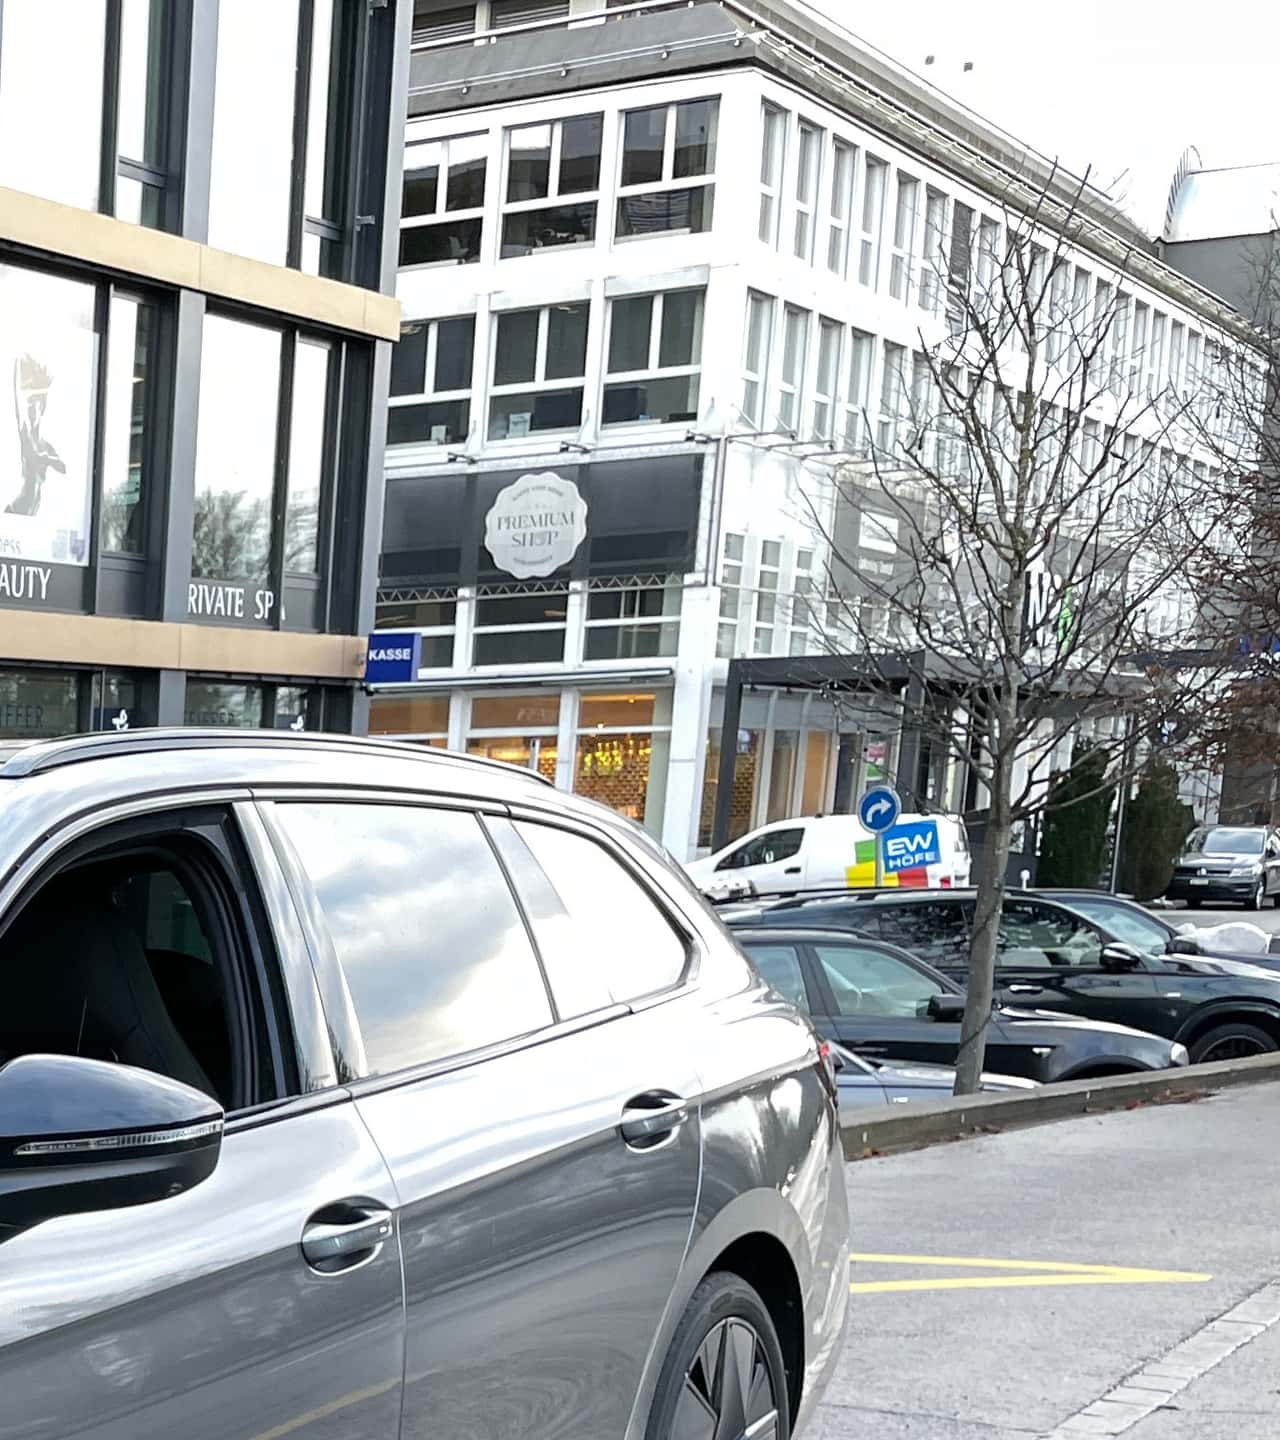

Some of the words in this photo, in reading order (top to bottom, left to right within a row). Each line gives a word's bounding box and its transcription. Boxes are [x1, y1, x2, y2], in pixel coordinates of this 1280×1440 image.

[497, 511, 574, 531] PREMIUM
[511, 530, 559, 548] SHOP
[368, 648, 412, 661] KASSE
[886, 831, 933, 857] EW
